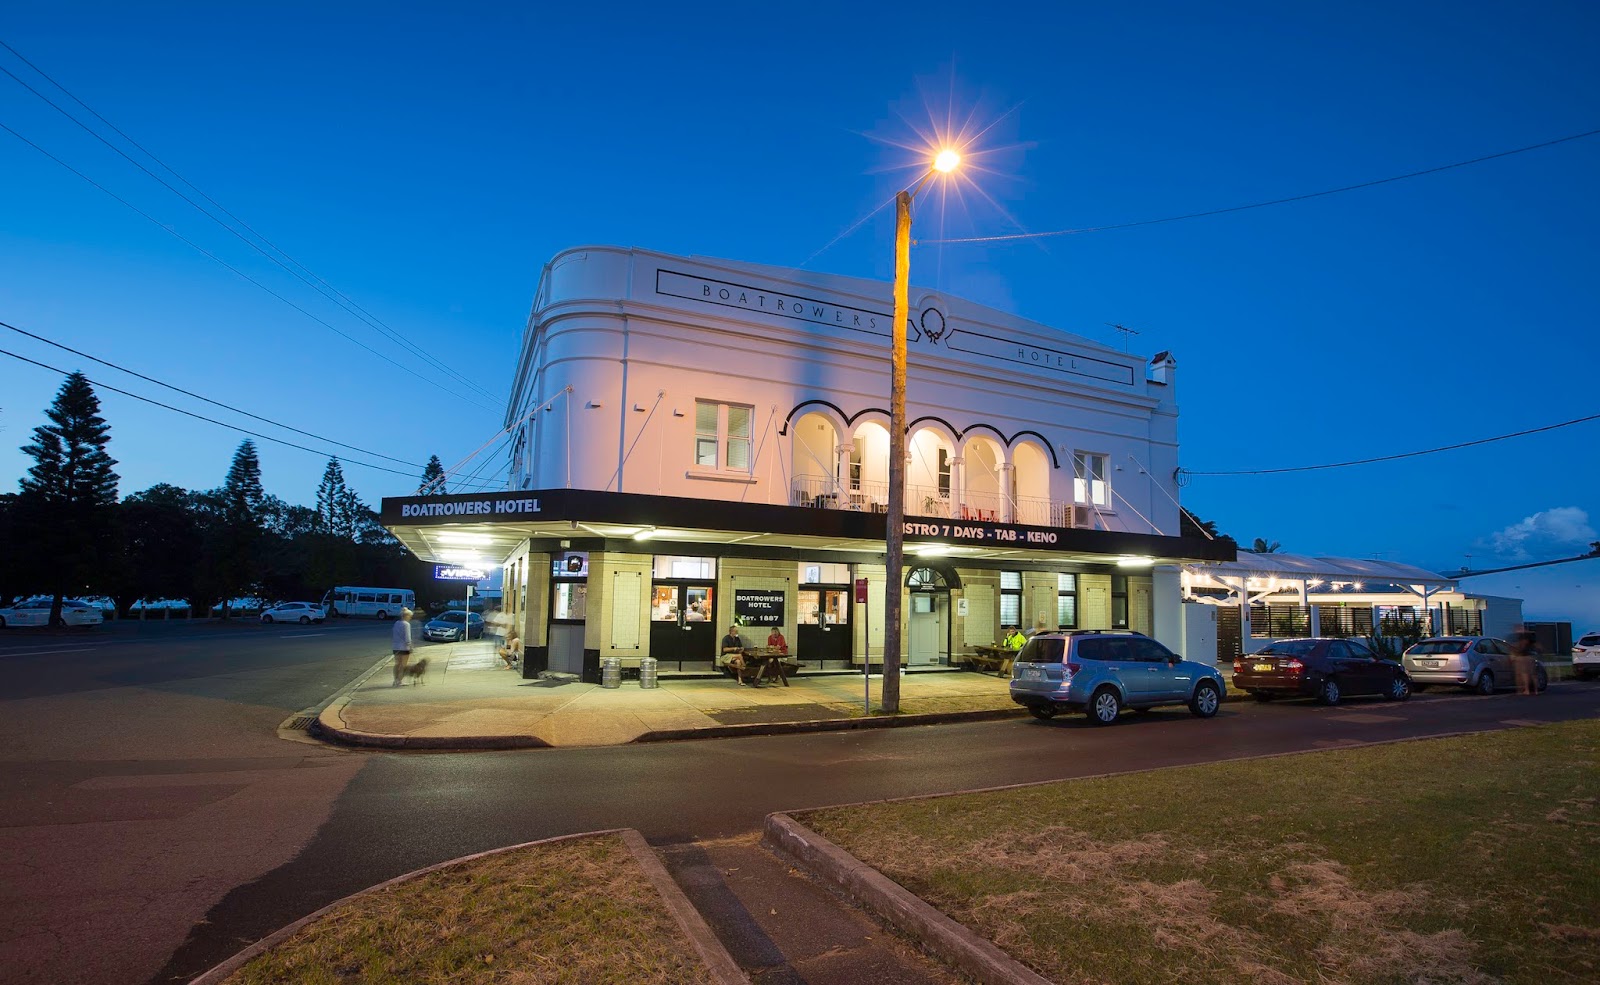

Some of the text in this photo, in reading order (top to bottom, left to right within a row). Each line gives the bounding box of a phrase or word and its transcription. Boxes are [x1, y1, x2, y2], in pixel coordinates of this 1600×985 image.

[703, 284, 1077, 369] BOATROWERS HOTEL
[402, 499, 541, 517] BOATROWERS HOTEL
[903, 522, 940, 536] ISTRO
[942, 525, 950, 536] 7
[953, 526, 985, 539] DAYS
[995, 529, 1017, 541] TAB
[1027, 531, 1058, 543] KENO
